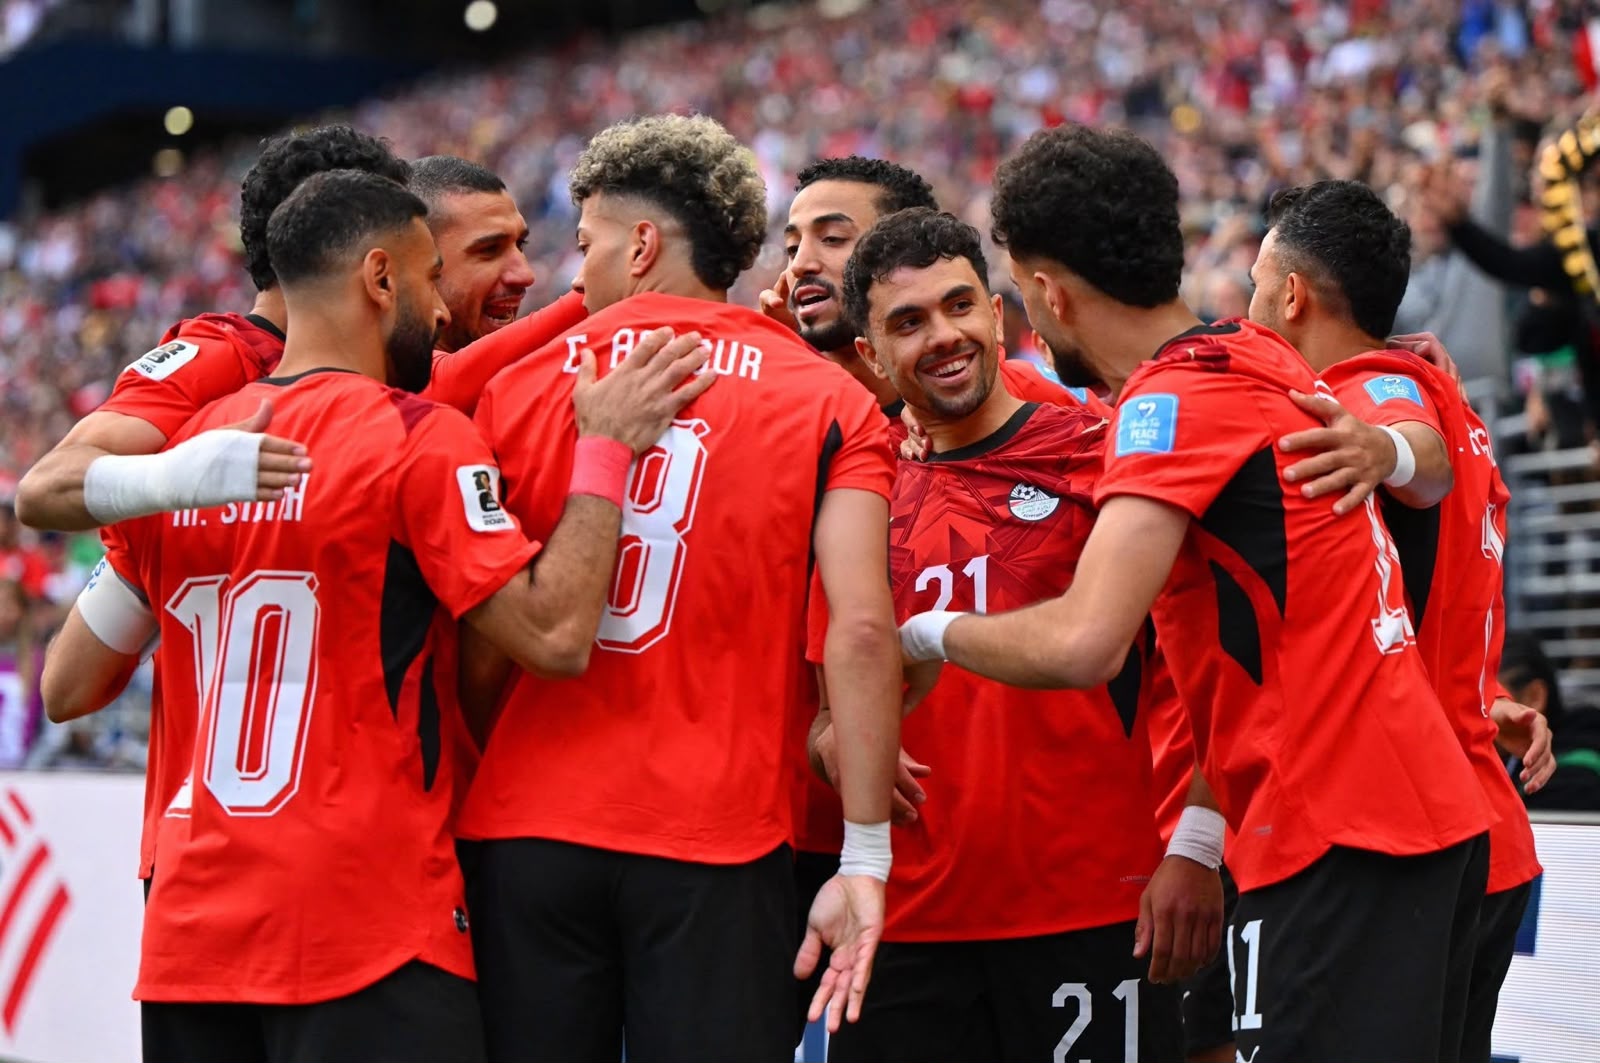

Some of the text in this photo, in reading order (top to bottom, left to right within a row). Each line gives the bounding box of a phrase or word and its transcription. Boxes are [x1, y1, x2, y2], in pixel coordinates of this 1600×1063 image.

[609, 328, 763, 381] AUR
[1130, 428, 1160, 441] PEACE
[594, 418, 711, 654] 8
[164, 569, 321, 817] 10
[1051, 978, 1142, 1063] 21
